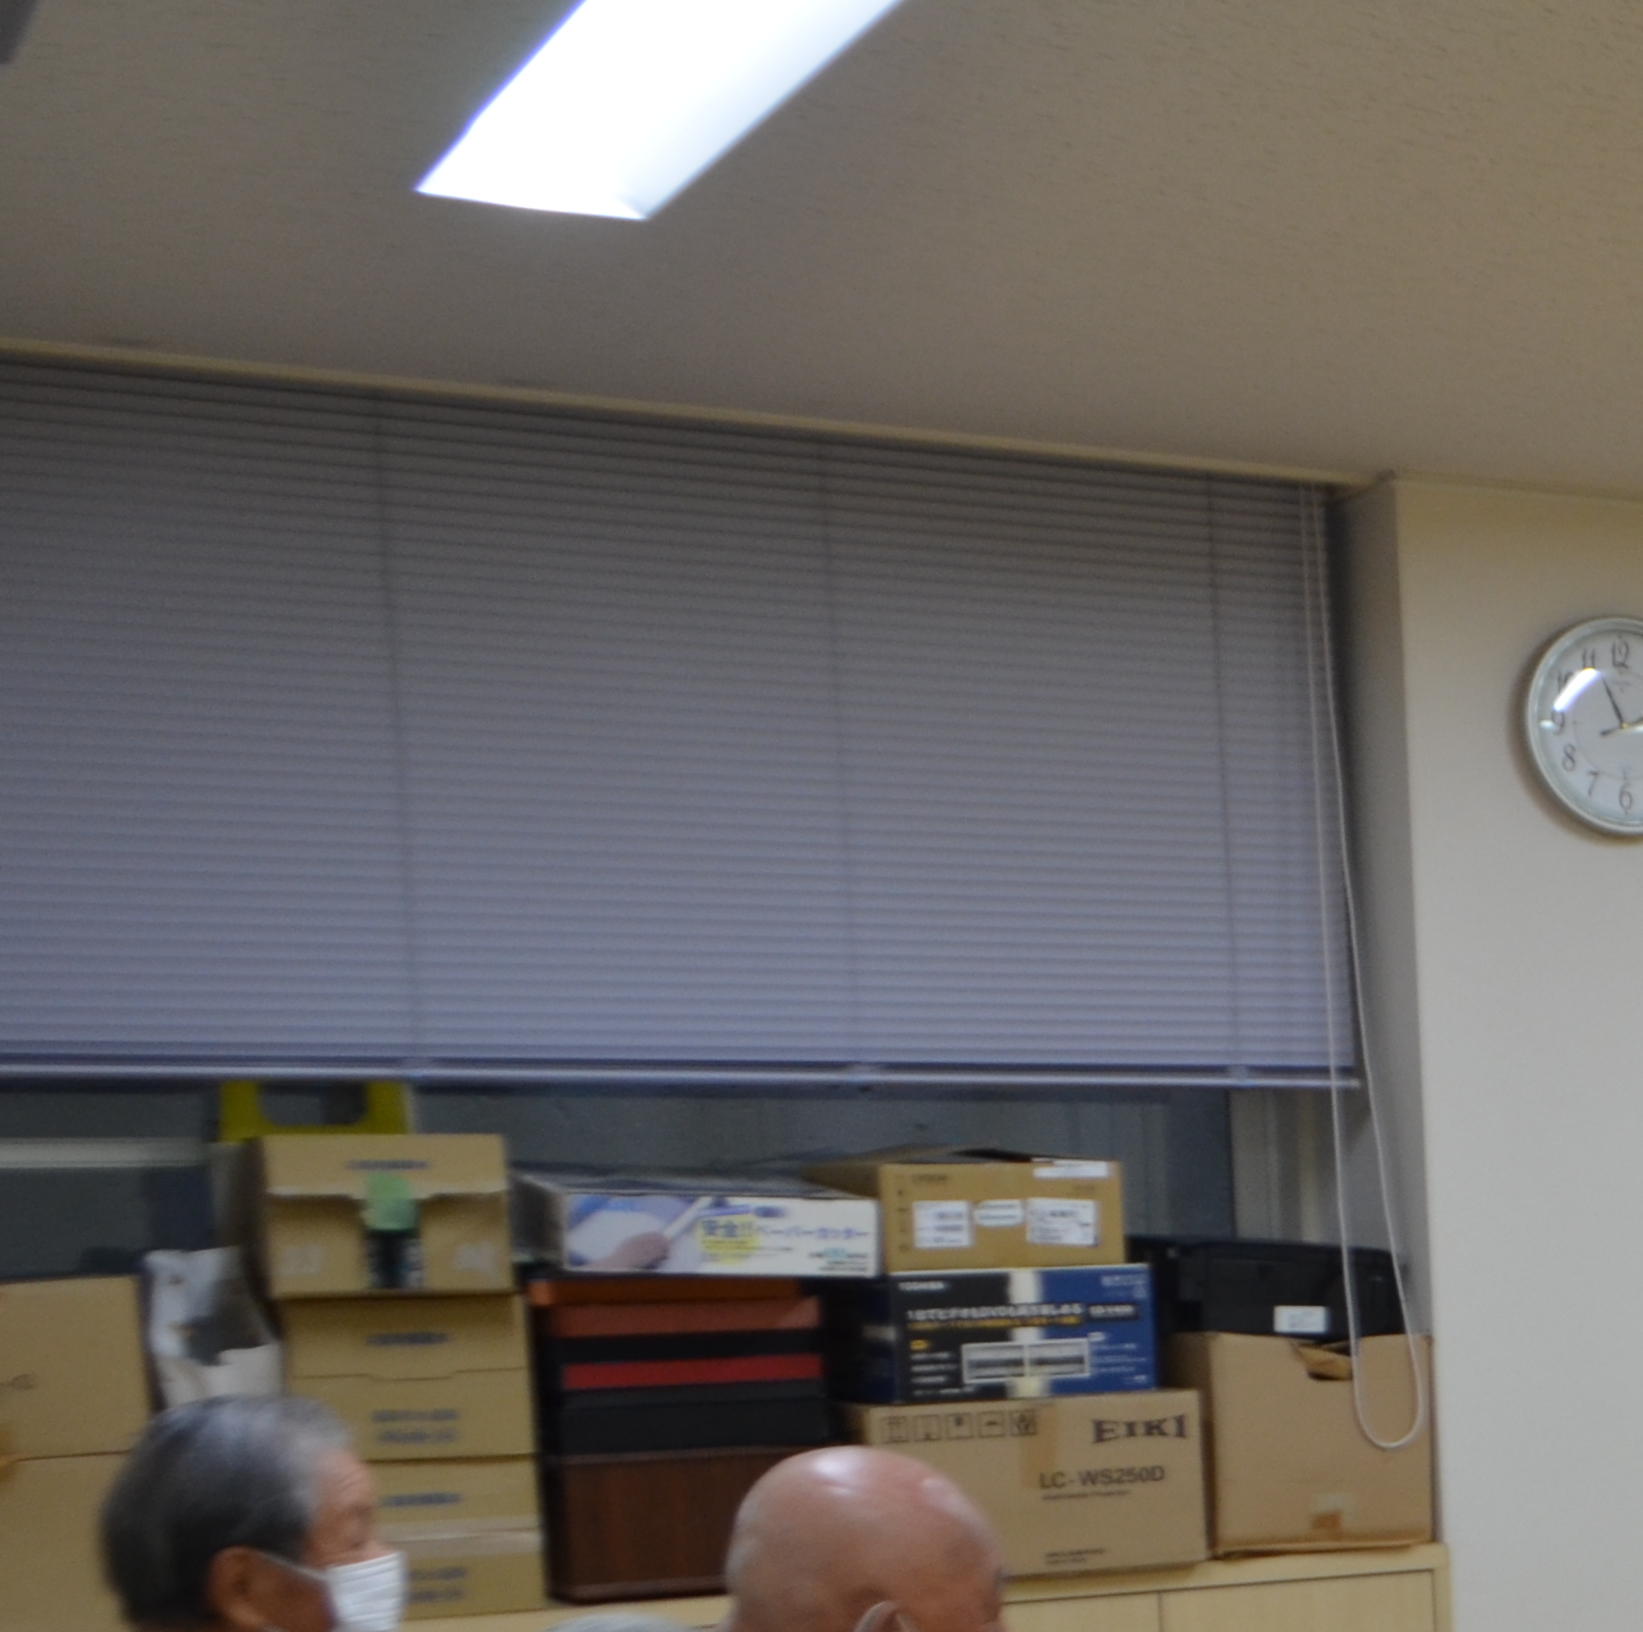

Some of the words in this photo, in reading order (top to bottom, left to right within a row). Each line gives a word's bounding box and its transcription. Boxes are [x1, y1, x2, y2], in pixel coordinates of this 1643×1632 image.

[1610, 638, 1631, 670] 12
[1561, 743, 1577, 772] 8
[1586, 770, 1600, 798] 7
[1618, 783, 1633, 811] 6
[1092, 1413, 1188, 1444] EIKI
[1038, 1464, 1166, 1490] LC-WS250D
